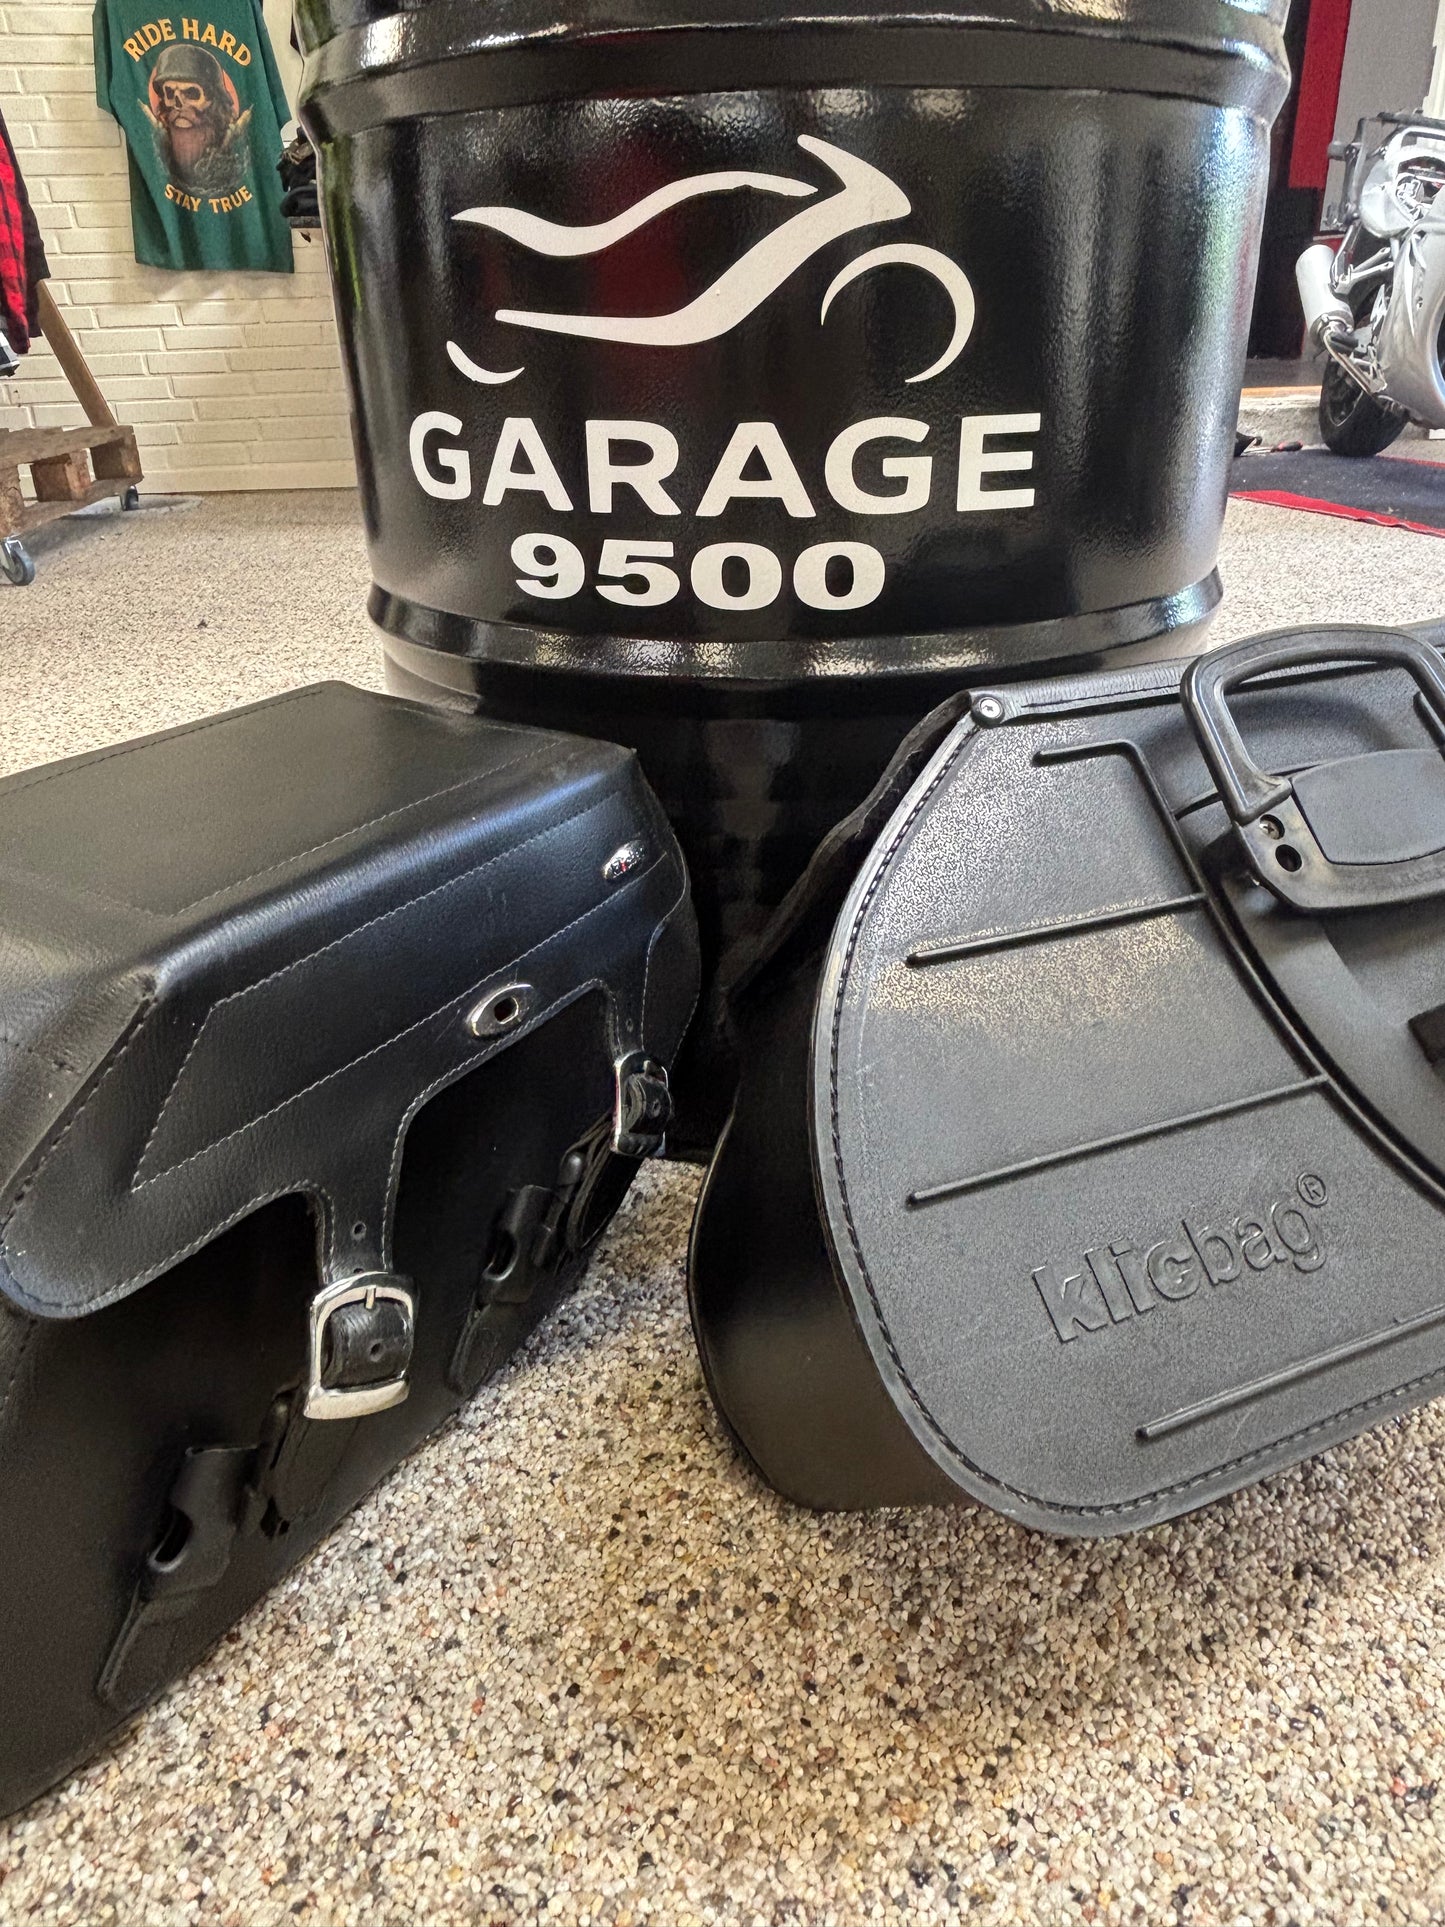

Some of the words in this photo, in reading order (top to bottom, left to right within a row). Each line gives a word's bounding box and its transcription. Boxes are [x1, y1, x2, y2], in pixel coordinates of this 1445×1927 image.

[123, 19, 176, 62] RIDE
[182, 17, 252, 67] HARD
[164, 184, 200, 212] STAY
[208, 185, 253, 214] TRUE
[409, 411, 1041, 517] GARAGE
[510, 532, 885, 610] 9500
